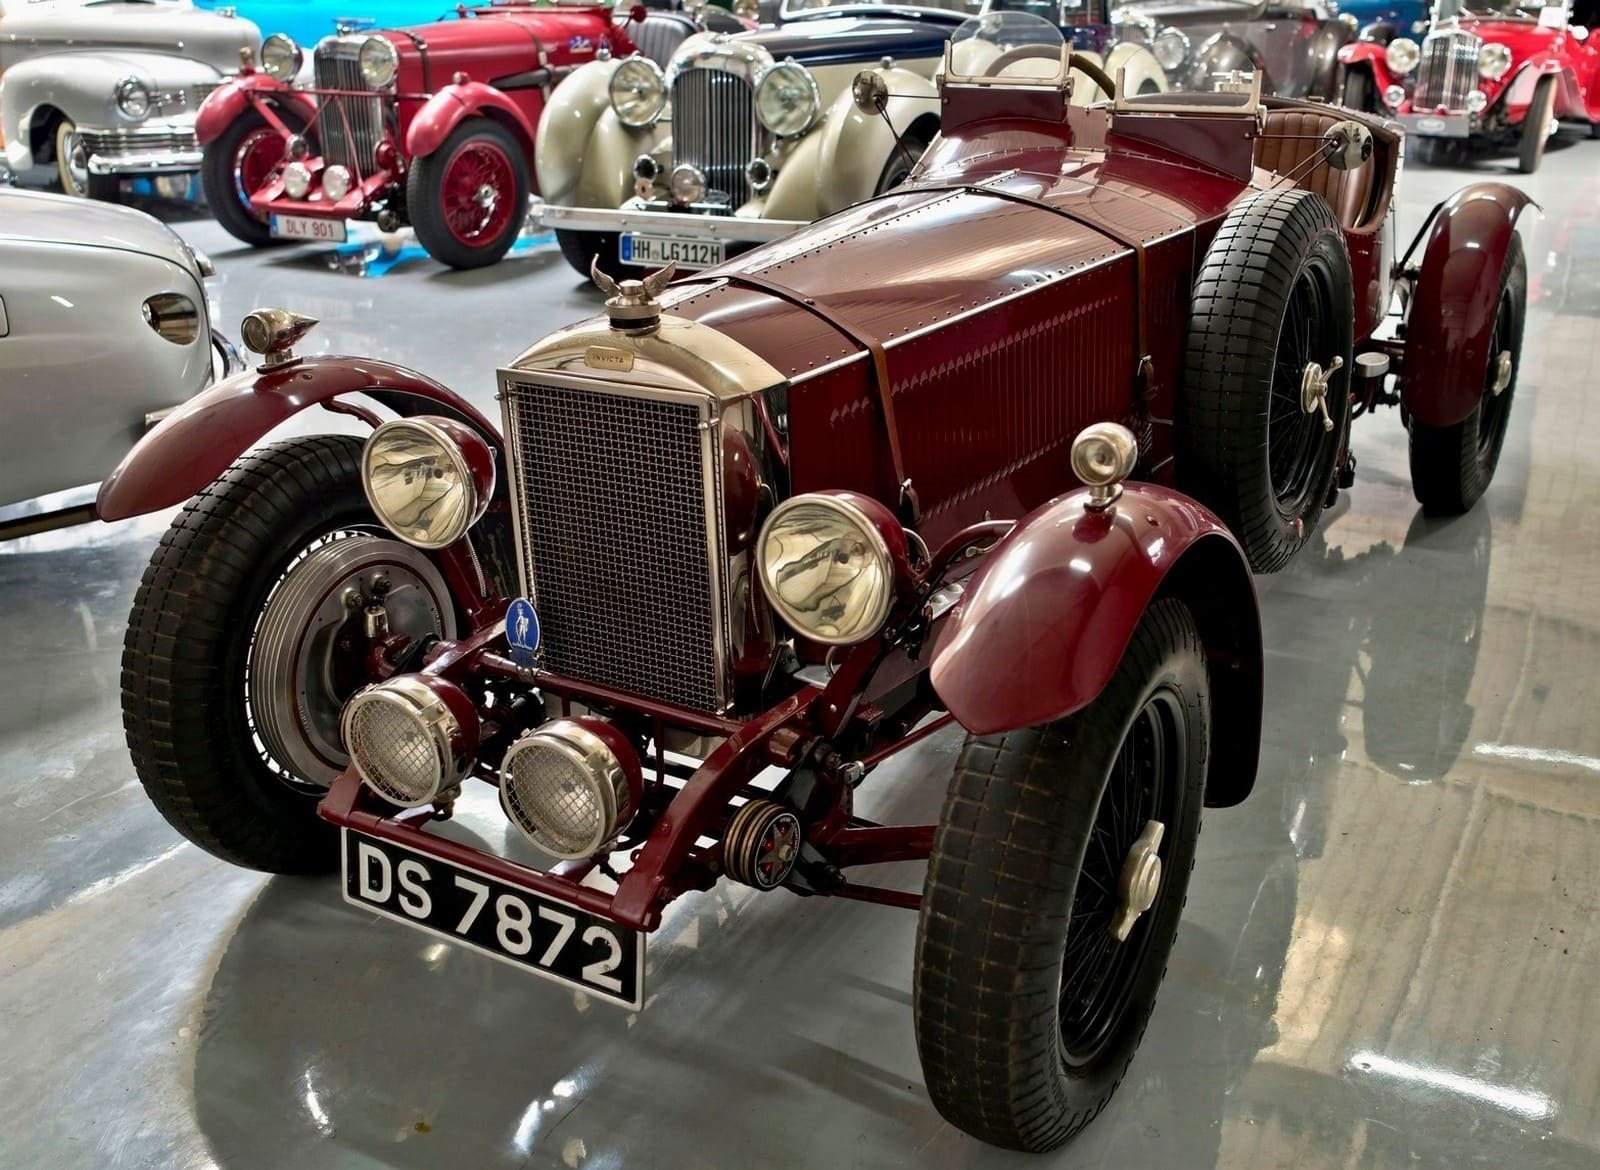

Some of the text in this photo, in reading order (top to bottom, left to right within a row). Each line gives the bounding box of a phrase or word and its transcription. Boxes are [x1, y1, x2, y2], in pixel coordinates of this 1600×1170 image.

[286, 219, 334, 238] DLY 901
[632, 240, 650, 259] HH
[592, 352, 625, 364] INVICTA
[358, 841, 623, 994] DS 7872
